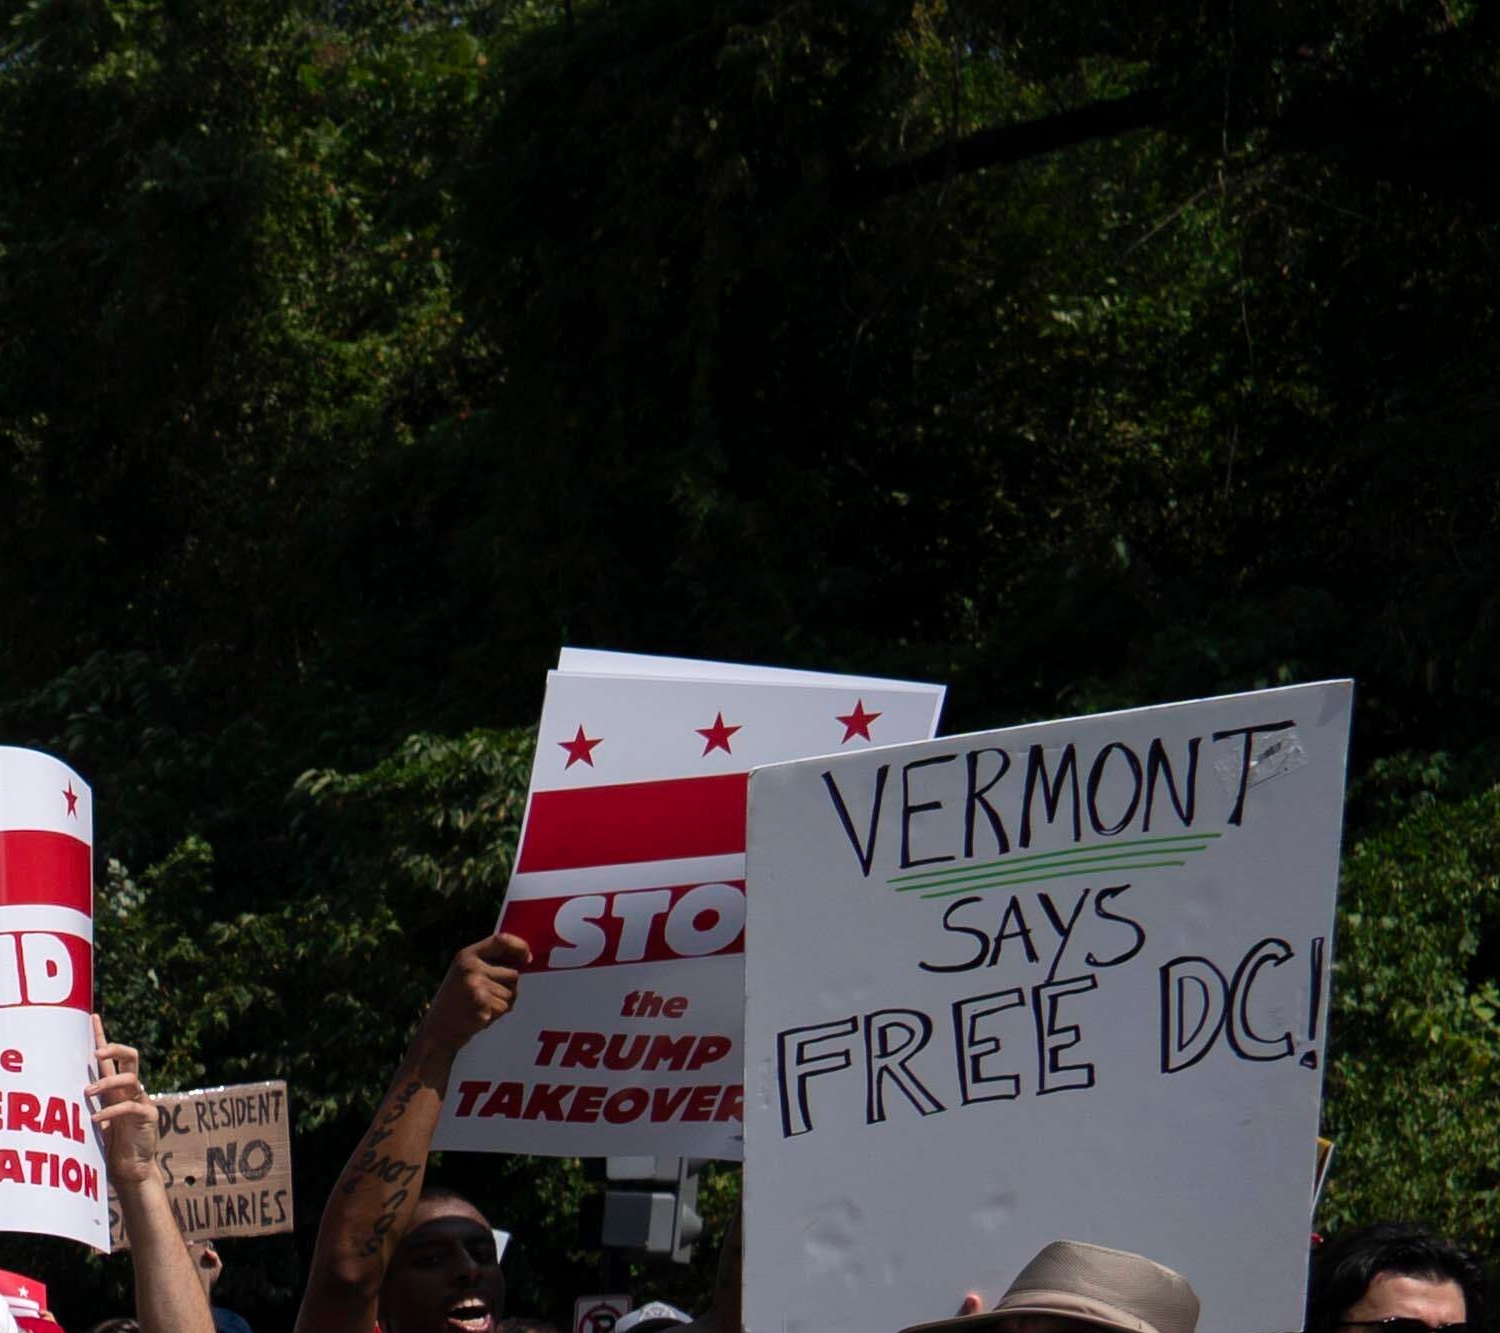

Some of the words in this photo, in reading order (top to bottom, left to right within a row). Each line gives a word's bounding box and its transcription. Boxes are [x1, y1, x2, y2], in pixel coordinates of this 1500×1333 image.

[821, 719, 1297, 877] VERMONT
[548, 883, 745, 969] STO
[918, 884, 1146, 982] SAYS
[620, 990, 688, 1019] the
[534, 1030, 732, 1071] TRUMP
[777, 974, 1098, 1138] FREE
[1159, 937, 1325, 1074] DC!
[158, 1105, 190, 1138] DC
[195, 1090, 283, 1134] RESIDENT
[455, 1081, 744, 1124] TAKEOVER
[206, 1139, 273, 1187] NO
